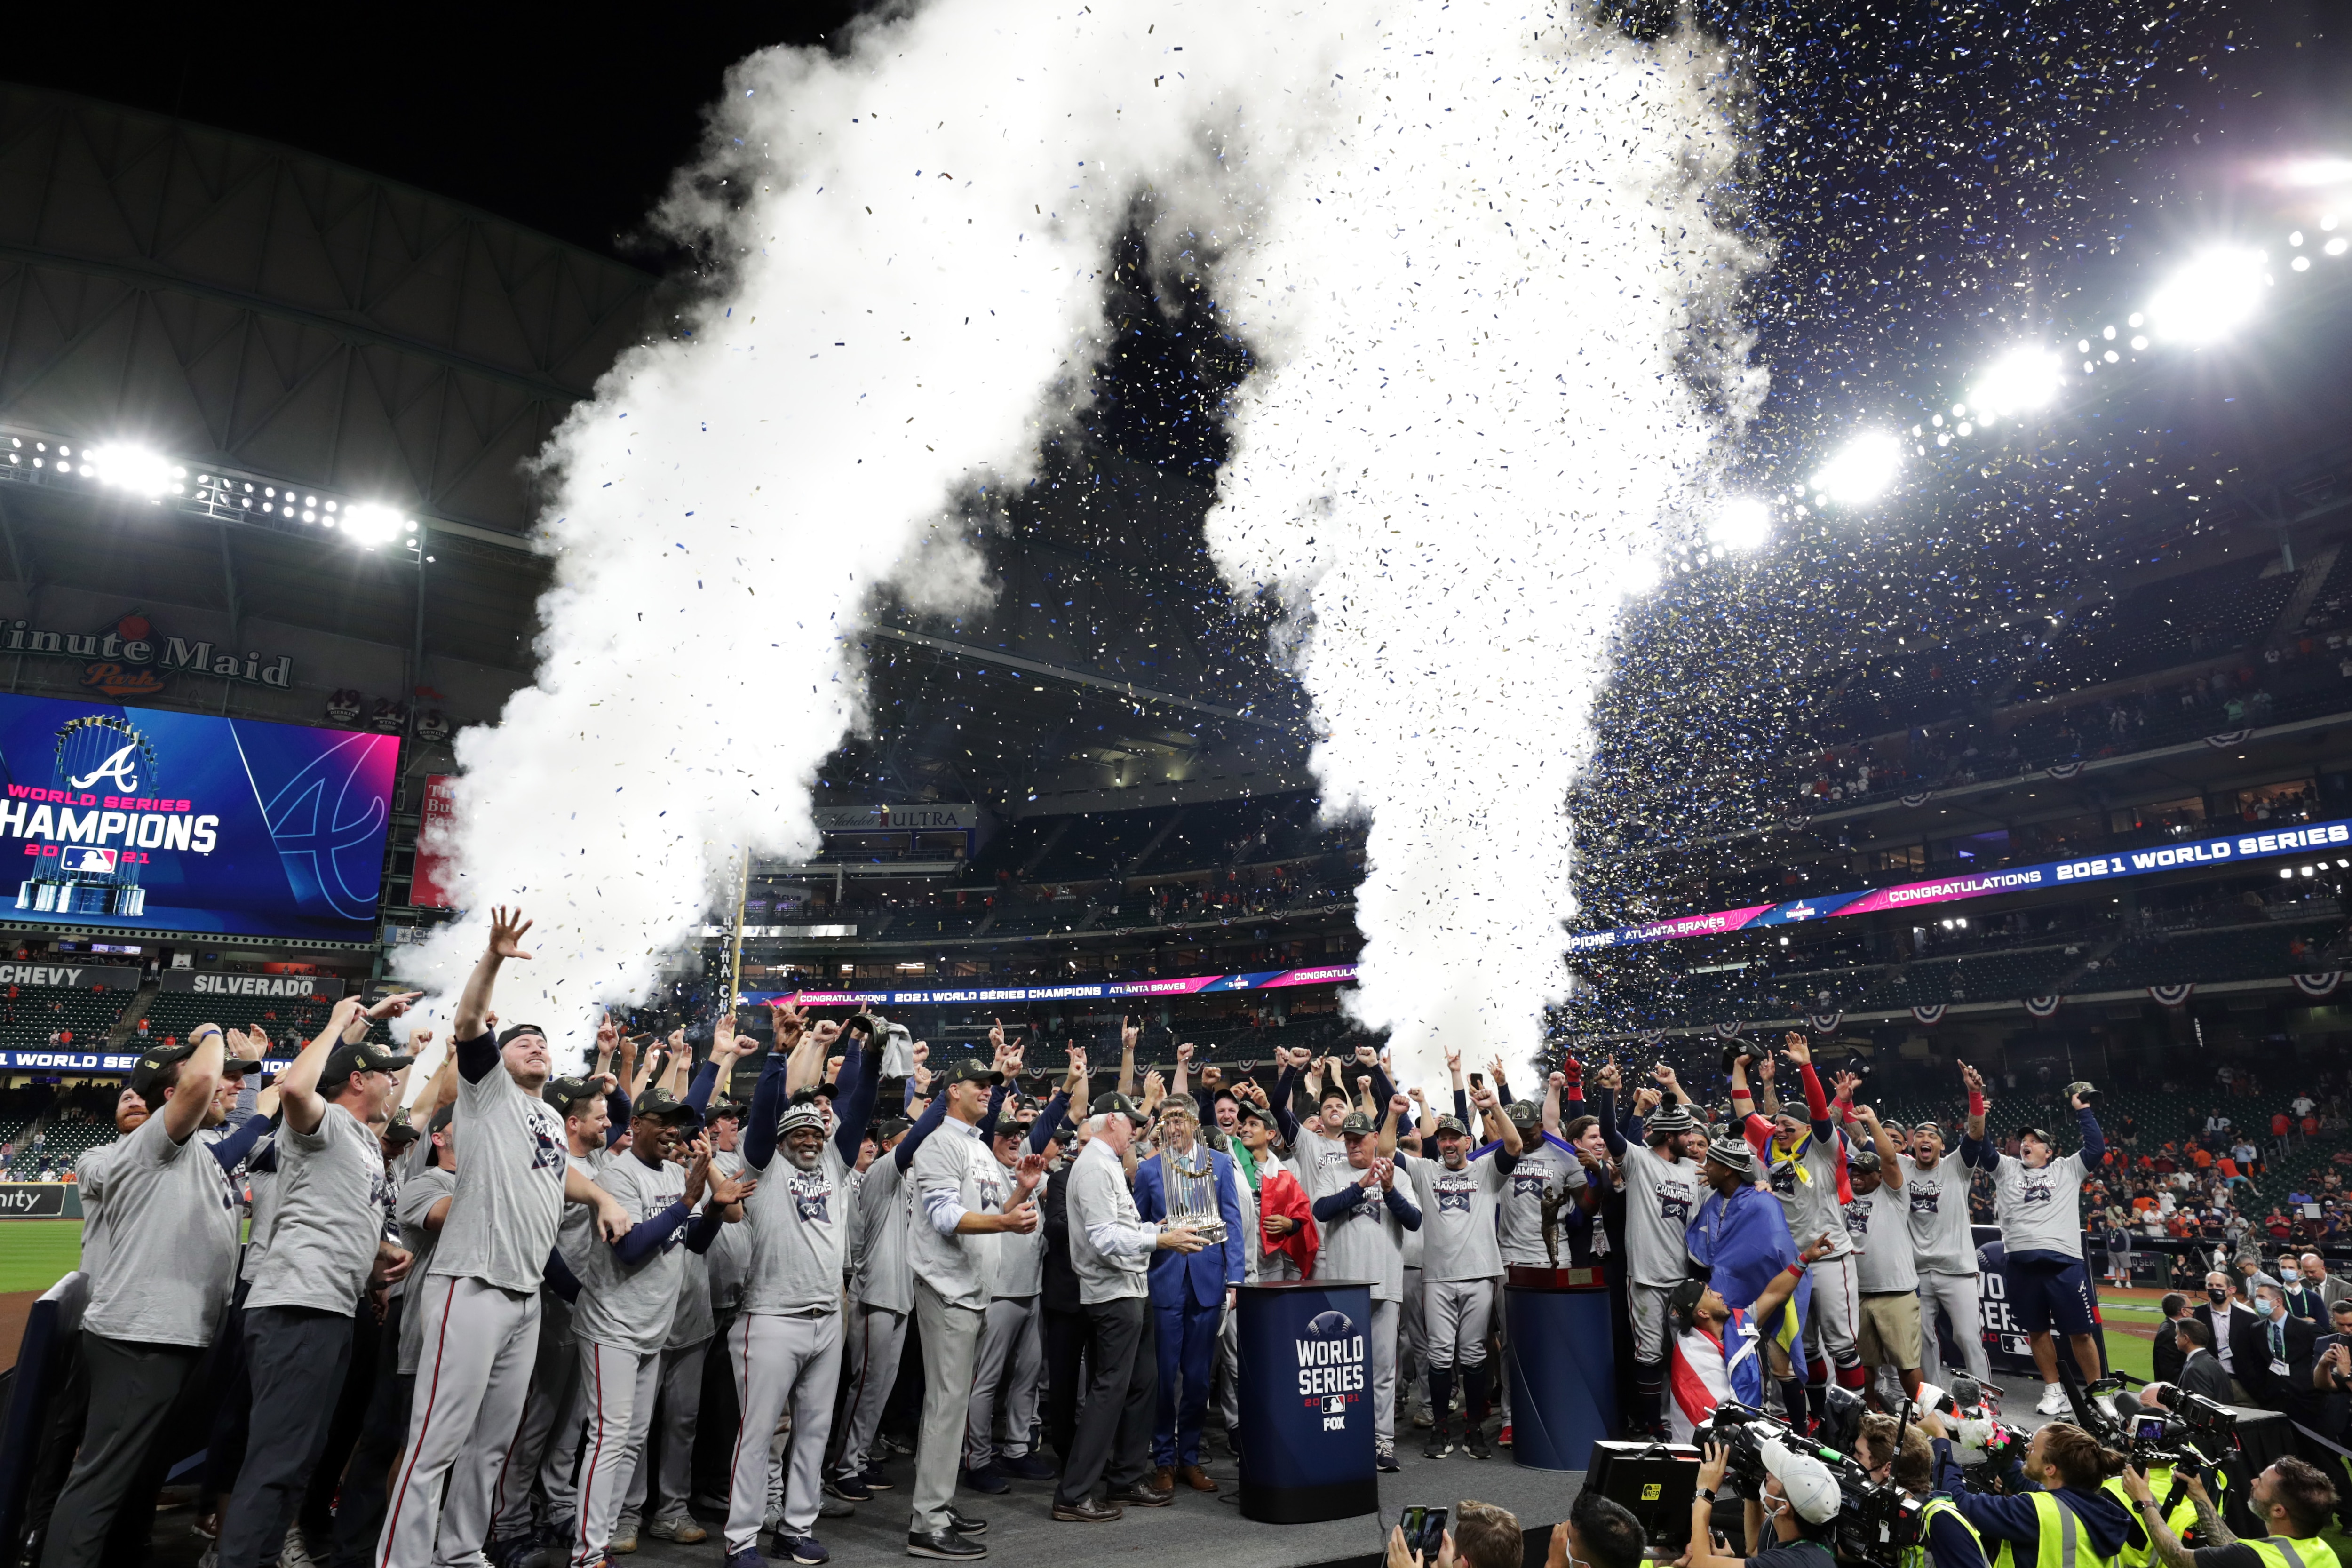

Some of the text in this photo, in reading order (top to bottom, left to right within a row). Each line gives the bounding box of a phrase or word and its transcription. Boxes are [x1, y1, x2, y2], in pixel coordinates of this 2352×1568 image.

[0, 620, 291, 687] inute Maid
[81, 663, 161, 689] Park
[328, 688, 360, 708] 49
[375, 697, 404, 719] 24
[426, 709, 442, 728] 5
[8, 784, 191, 812] WORLD SERIES
[429, 784, 453, 799] Th
[0, 799, 219, 852] HAMPIONS
[814, 812, 959, 827] Michelob ULTRA
[24, 844, 150, 864] 20 21
[1889, 825, 2349, 902] CONGRATULATIONS 2021 WORLD SERIES
[723, 916, 733, 930] 4
[1625, 925, 1675, 940] ATLANTA
[1677, 918, 1725, 932] BRAVES
[720, 936, 733, 978] THA
[0, 965, 314, 996] CHEVY SILVERADO
[800, 994, 887, 1003] CONGRATULATIONS
[894, 993, 930, 1002] 2021
[932, 992, 977, 1001] WORLD
[979, 989, 1025, 1000] SERIES
[1028, 986, 1101, 999] CHAMPIONS
[1151, 982, 1186, 992] BRAVES
[16, 1053, 98, 1067] WORLD
[1727, 1141, 1749, 1152] CHAM
[1432, 1180, 1478, 1192] CHAMPIONS
[1655, 1183, 1695, 1203] CHAMPIONS
[1295, 1335, 1364, 1367] WORLD
[1299, 1364, 1364, 1395] SERIES
[1304, 1394, 1359, 1407] 20 21
[1323, 1416, 1345, 1431] FOX
